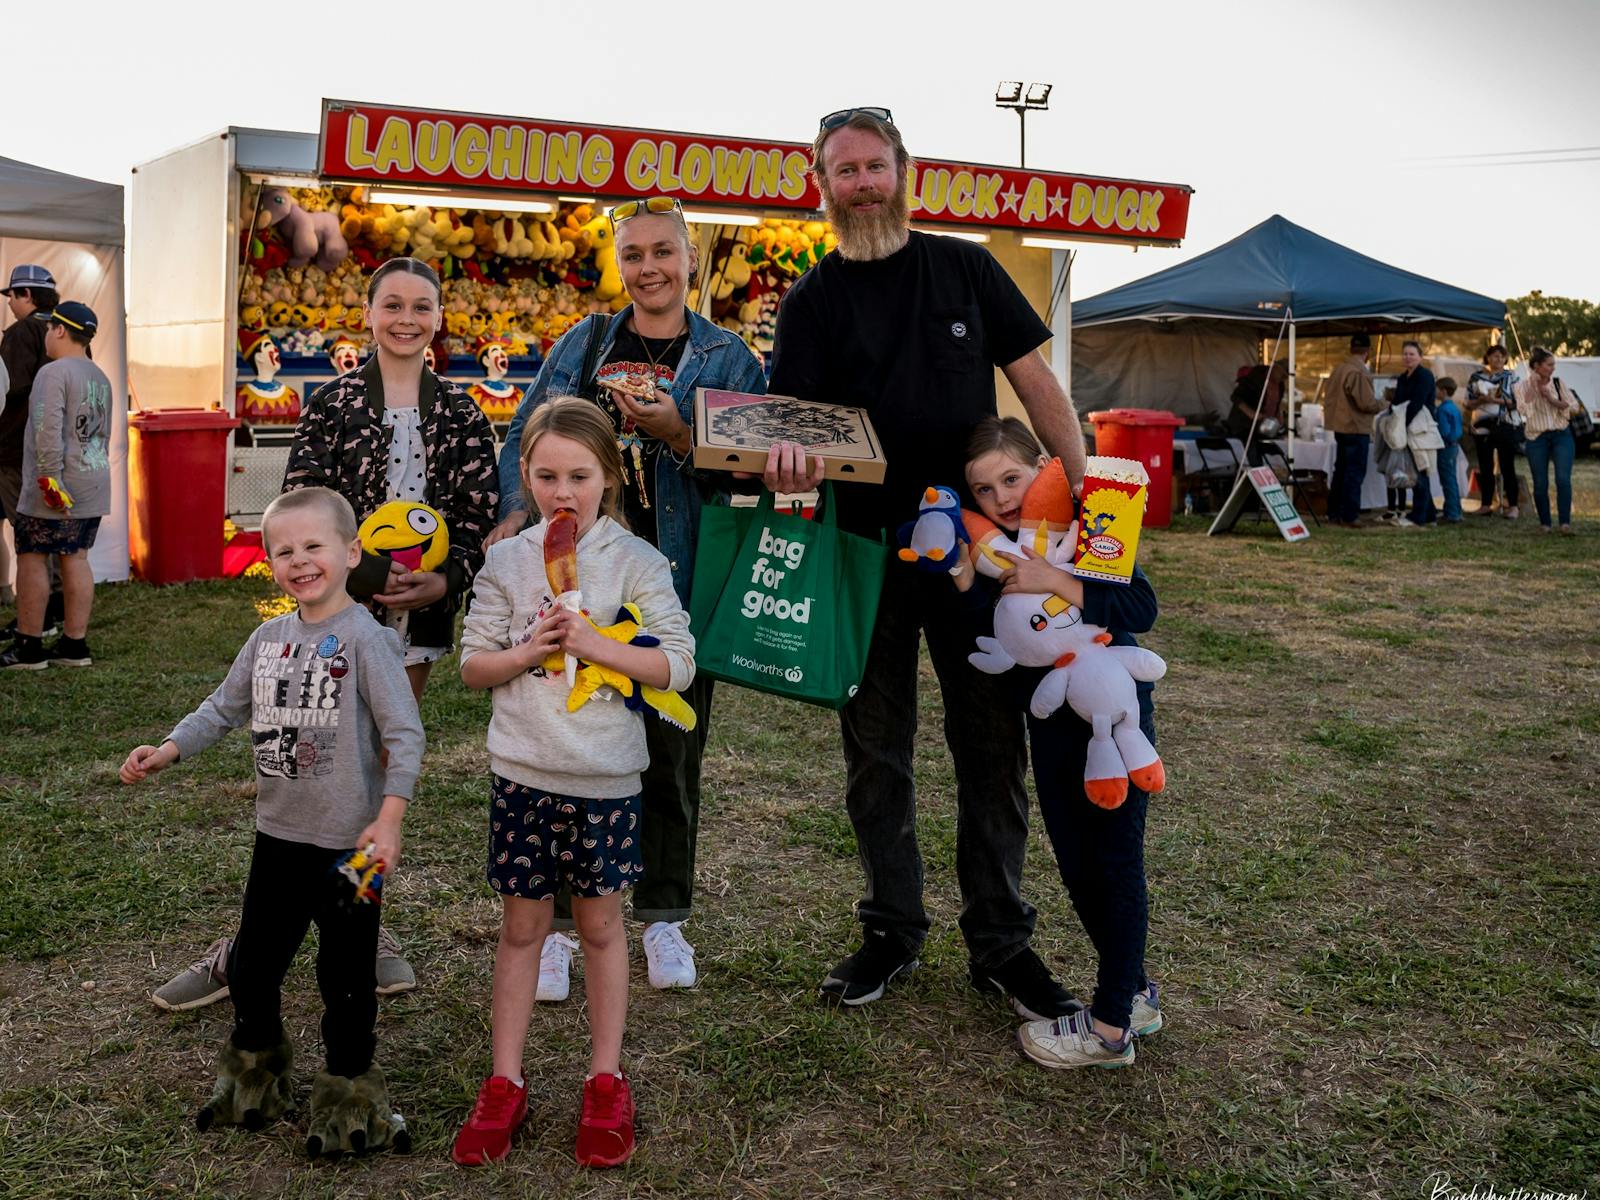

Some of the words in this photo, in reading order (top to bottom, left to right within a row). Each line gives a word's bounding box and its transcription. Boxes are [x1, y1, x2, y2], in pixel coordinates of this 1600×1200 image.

[346, 112, 614, 187] LAUGHING
[624, 138, 810, 199] CLOWNS
[905, 166, 1003, 219] LUCK
[1068, 182, 1165, 233] DUCK
[757, 526, 806, 570] bag
[1088, 547, 1120, 560] POPCORN
[1094, 543, 1115, 551] LARGE
[751, 557, 785, 590] for
[740, 589, 812, 625] good
[732, 653, 784, 678] Woolworths
[252, 677, 290, 707] URE
[253, 704, 341, 727] LOCOMOTIVE
